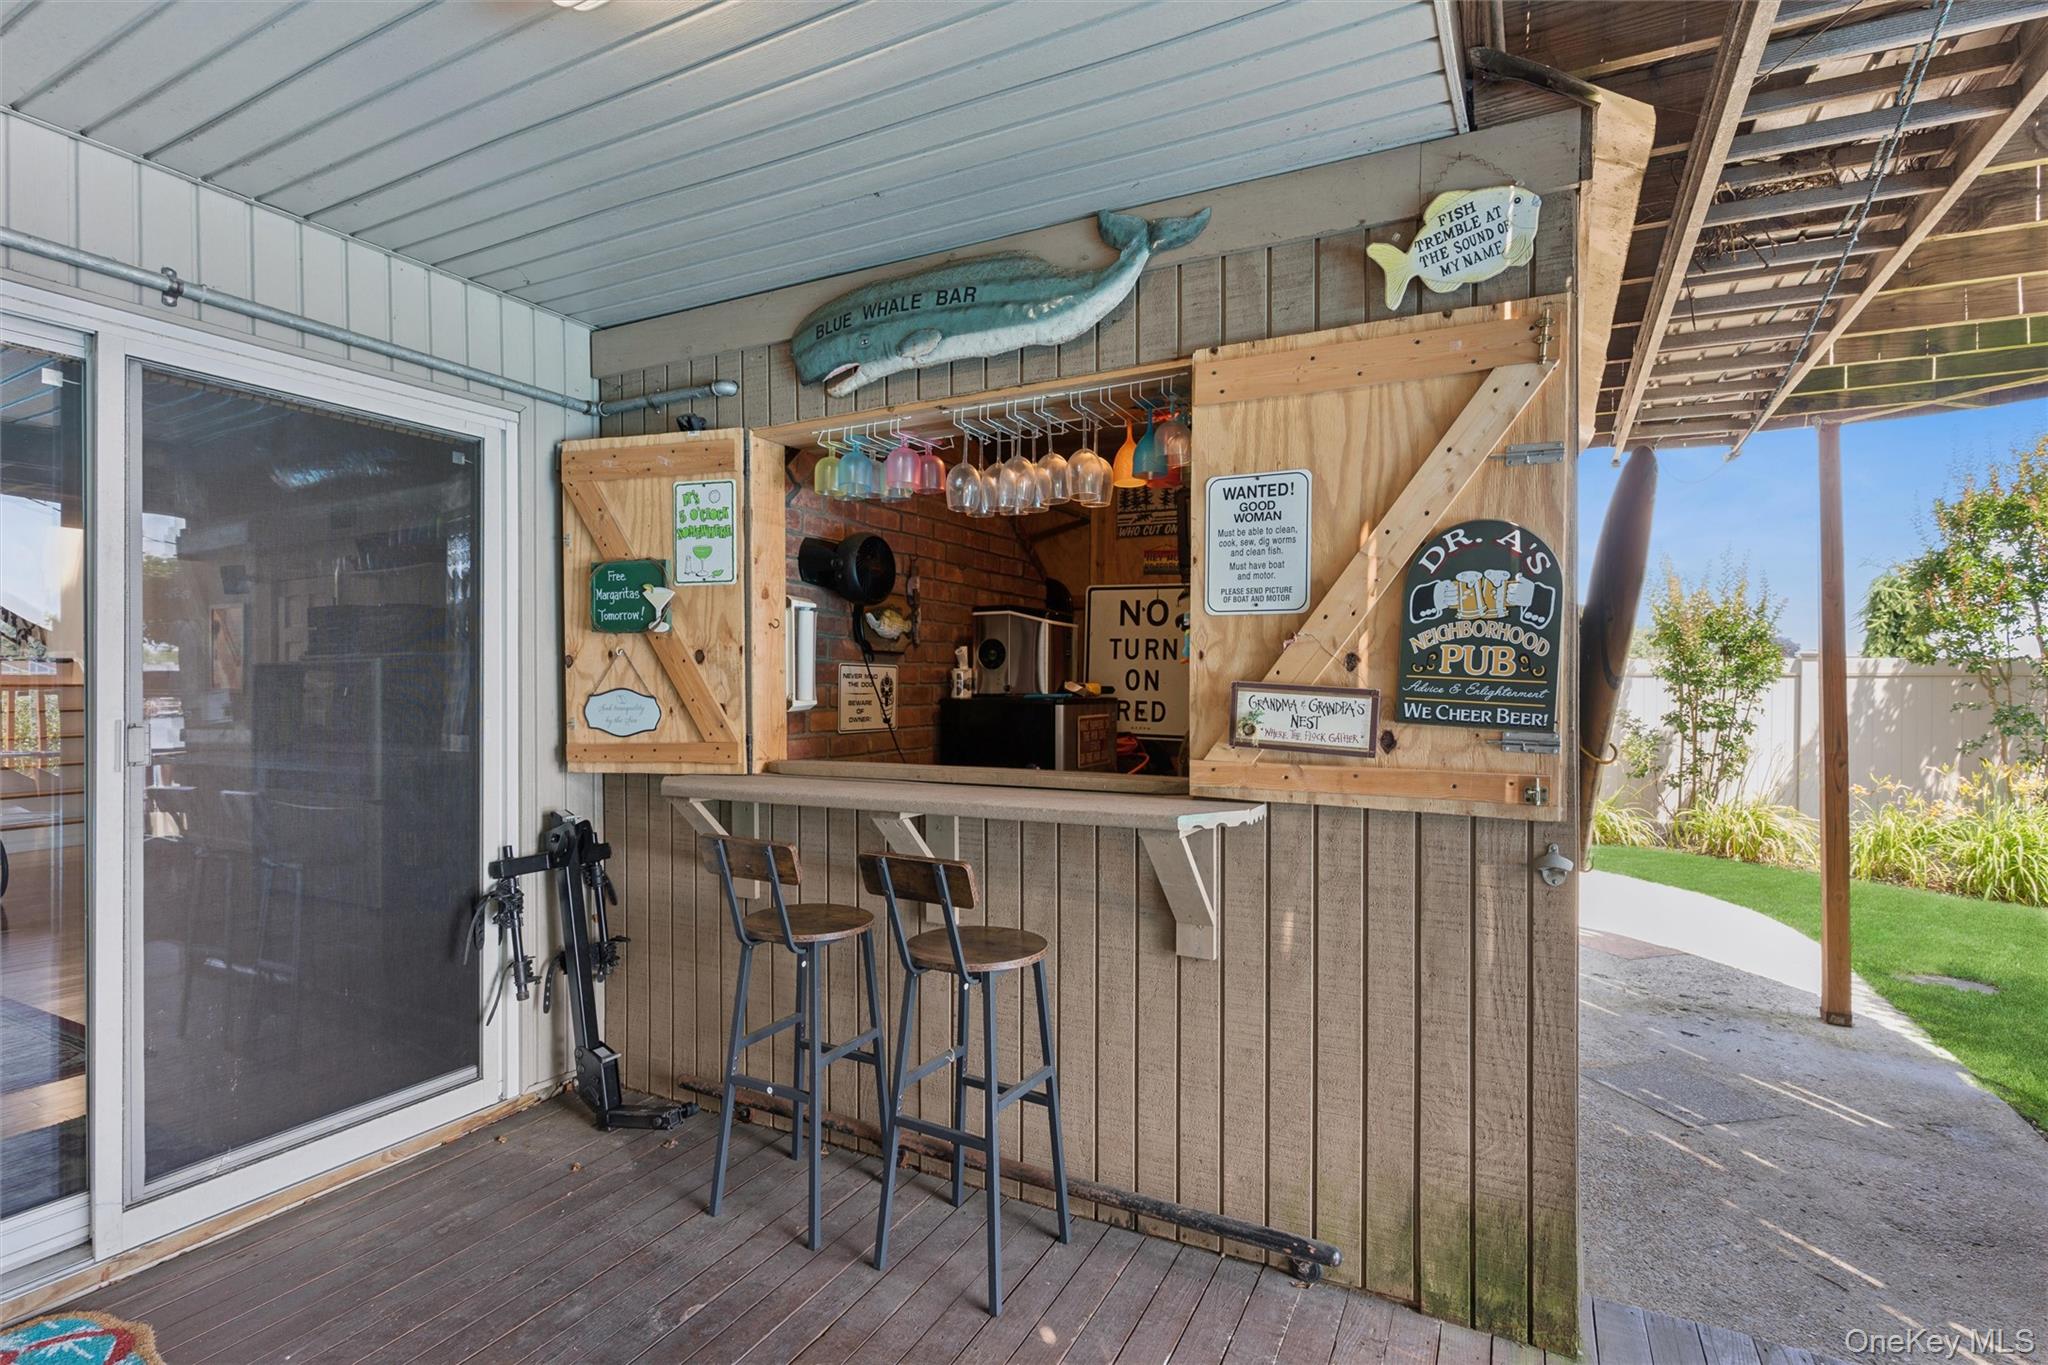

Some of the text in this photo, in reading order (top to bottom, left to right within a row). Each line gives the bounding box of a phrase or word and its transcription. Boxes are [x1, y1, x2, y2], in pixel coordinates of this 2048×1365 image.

[1438, 201, 1476, 227] FISH
[1414, 205, 1502, 253] TREMBLE AT
[1419, 219, 1509, 268] THE SOUND OF
[1440, 240, 1503, 277] MY NAME
[815, 286, 977, 340] BLUE WHALE BAR
[1222, 482, 1295, 501] WANTED!
[1239, 500, 1276, 513] GOOD
[678, 509, 688, 524] 5
[1233, 510, 1283, 523] WOMAN
[1119, 526, 1140, 537] WHO
[1143, 525, 1161, 536] CUT
[1217, 525, 1298, 538] Must be able to clean,
[1218, 536, 1297, 548] cook, sew, dig worms
[1230, 546, 1284, 557] and clean fish.
[1418, 528, 1552, 575] DR. A'S
[1229, 560, 1285, 570] Must have boat
[607, 570, 627, 582] Free
[1237, 571, 1276, 580] and motor.
[595, 587, 640, 605] Margaritas
[1220, 586, 1293, 595] PLEASE SEND PICTURE
[1232, 595, 1249, 603] BOAT
[1251, 595, 1265, 603] AND
[1266, 594, 1290, 602] MOTOR
[597, 606, 645, 622] Tomorrow!
[1120, 599, 1169, 627] NO
[1409, 620, 1551, 657] NEIGHBORHOOD
[1109, 638, 1178, 661] TURN
[1438, 644, 1517, 676] PUB
[1125, 668, 1159, 691] ON
[1402, 680, 1550, 701] Advice & Enlightenment
[1117, 700, 1166, 723] RED
[1248, 695, 1298, 714] GRANDMA
[1308, 698, 1366, 718] GRANDPA'S
[1403, 702, 1432, 719] WE
[1435, 704, 1492, 723] CHEER
[1290, 715, 1321, 730] NEST
